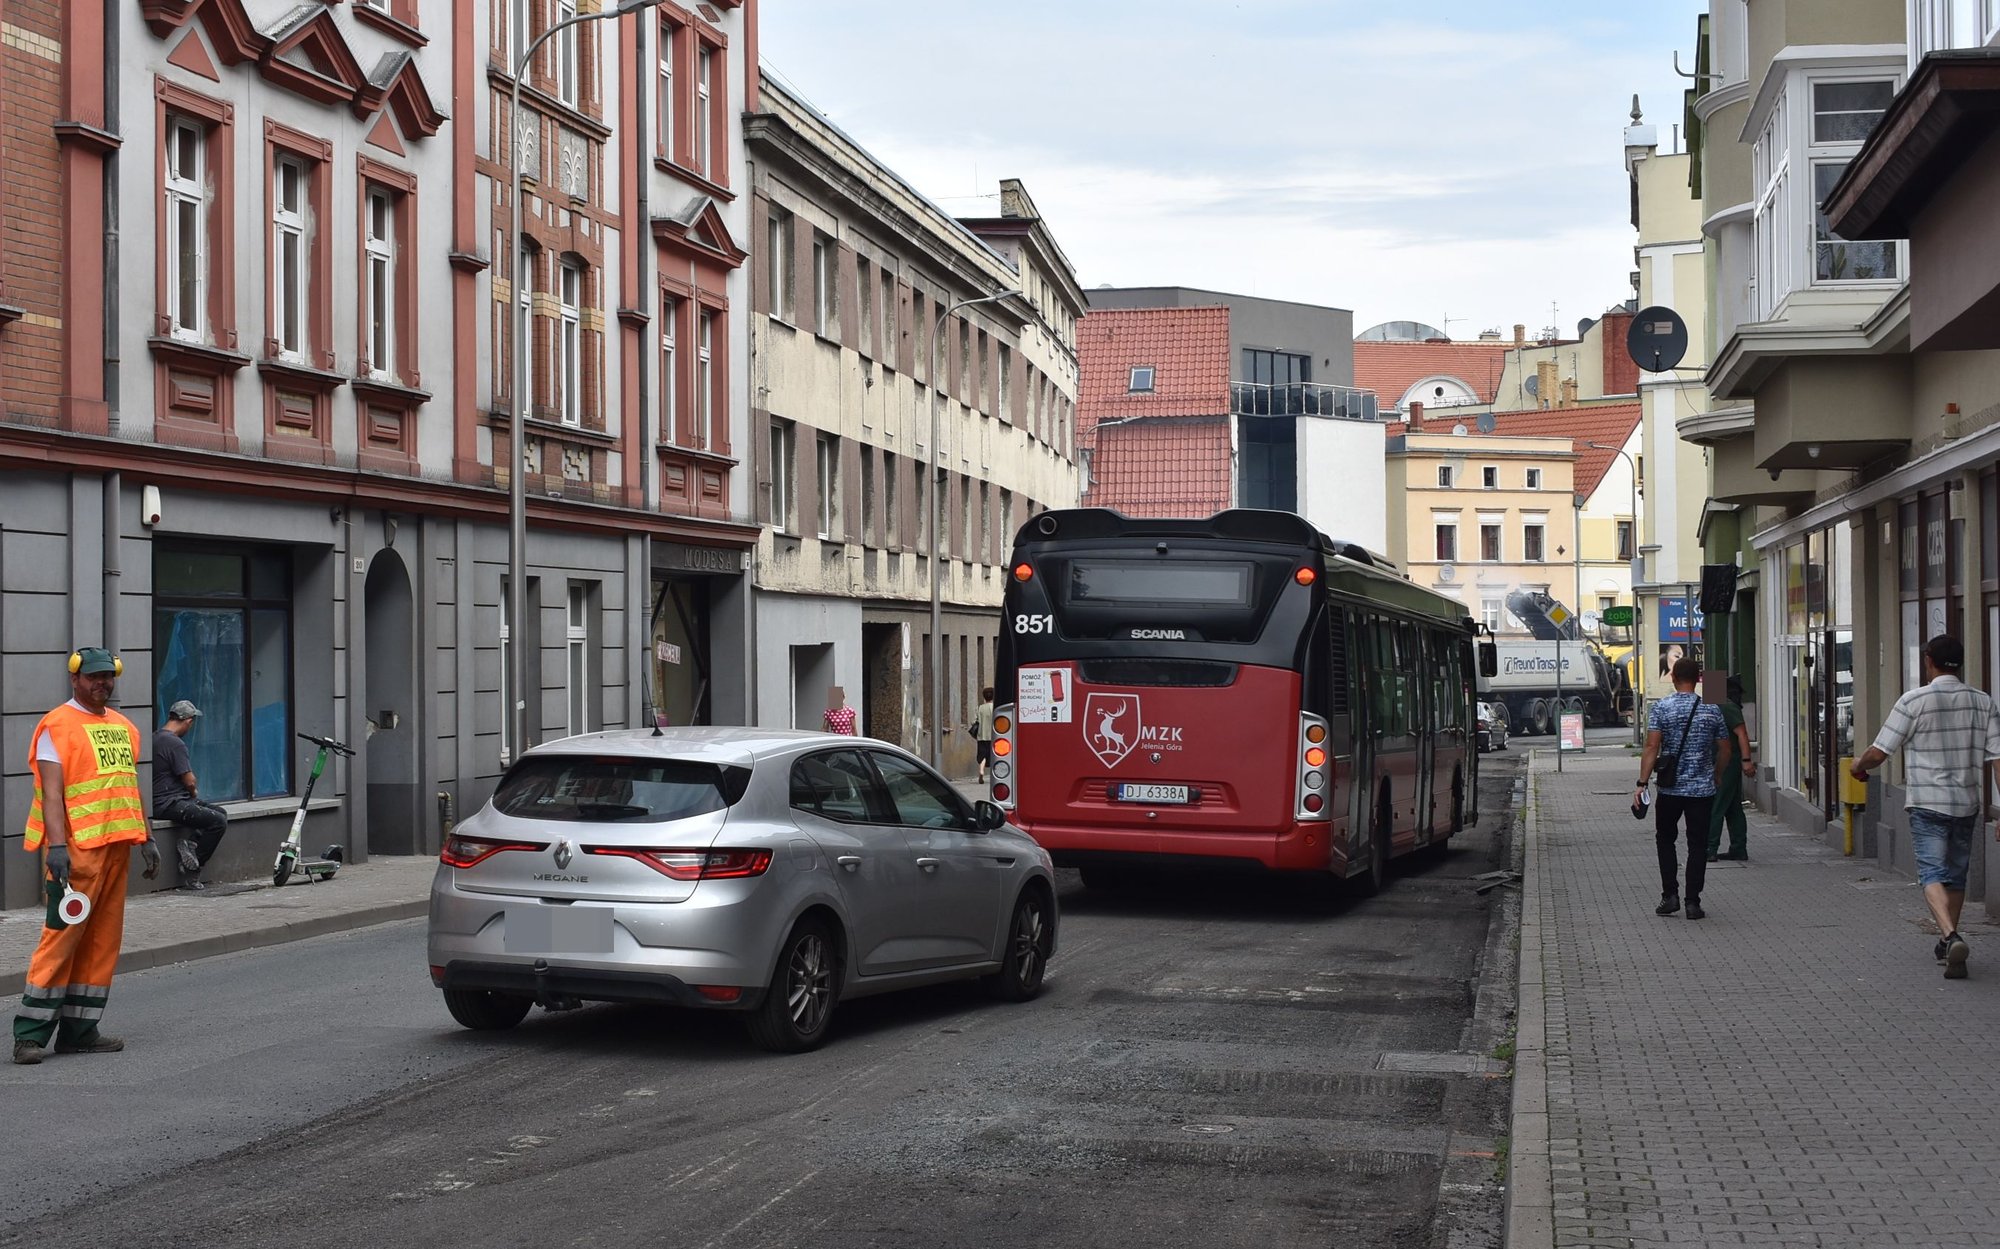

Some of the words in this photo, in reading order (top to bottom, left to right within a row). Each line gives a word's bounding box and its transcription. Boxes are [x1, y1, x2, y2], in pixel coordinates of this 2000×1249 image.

[355, 560, 363, 570] 20
[684, 548, 732, 570] MODESA
[1015, 614, 1054, 634] 851
[1130, 629, 1185, 640] SCANIA
[1513, 657, 1535, 670] Freund
[1141, 726, 1183, 741] MZK
[1166, 743, 1182, 751] Góra
[1126, 785, 1142, 798] DJ
[1146, 786, 1185, 800] 6338A
[533, 874, 589, 883] MEGANE
